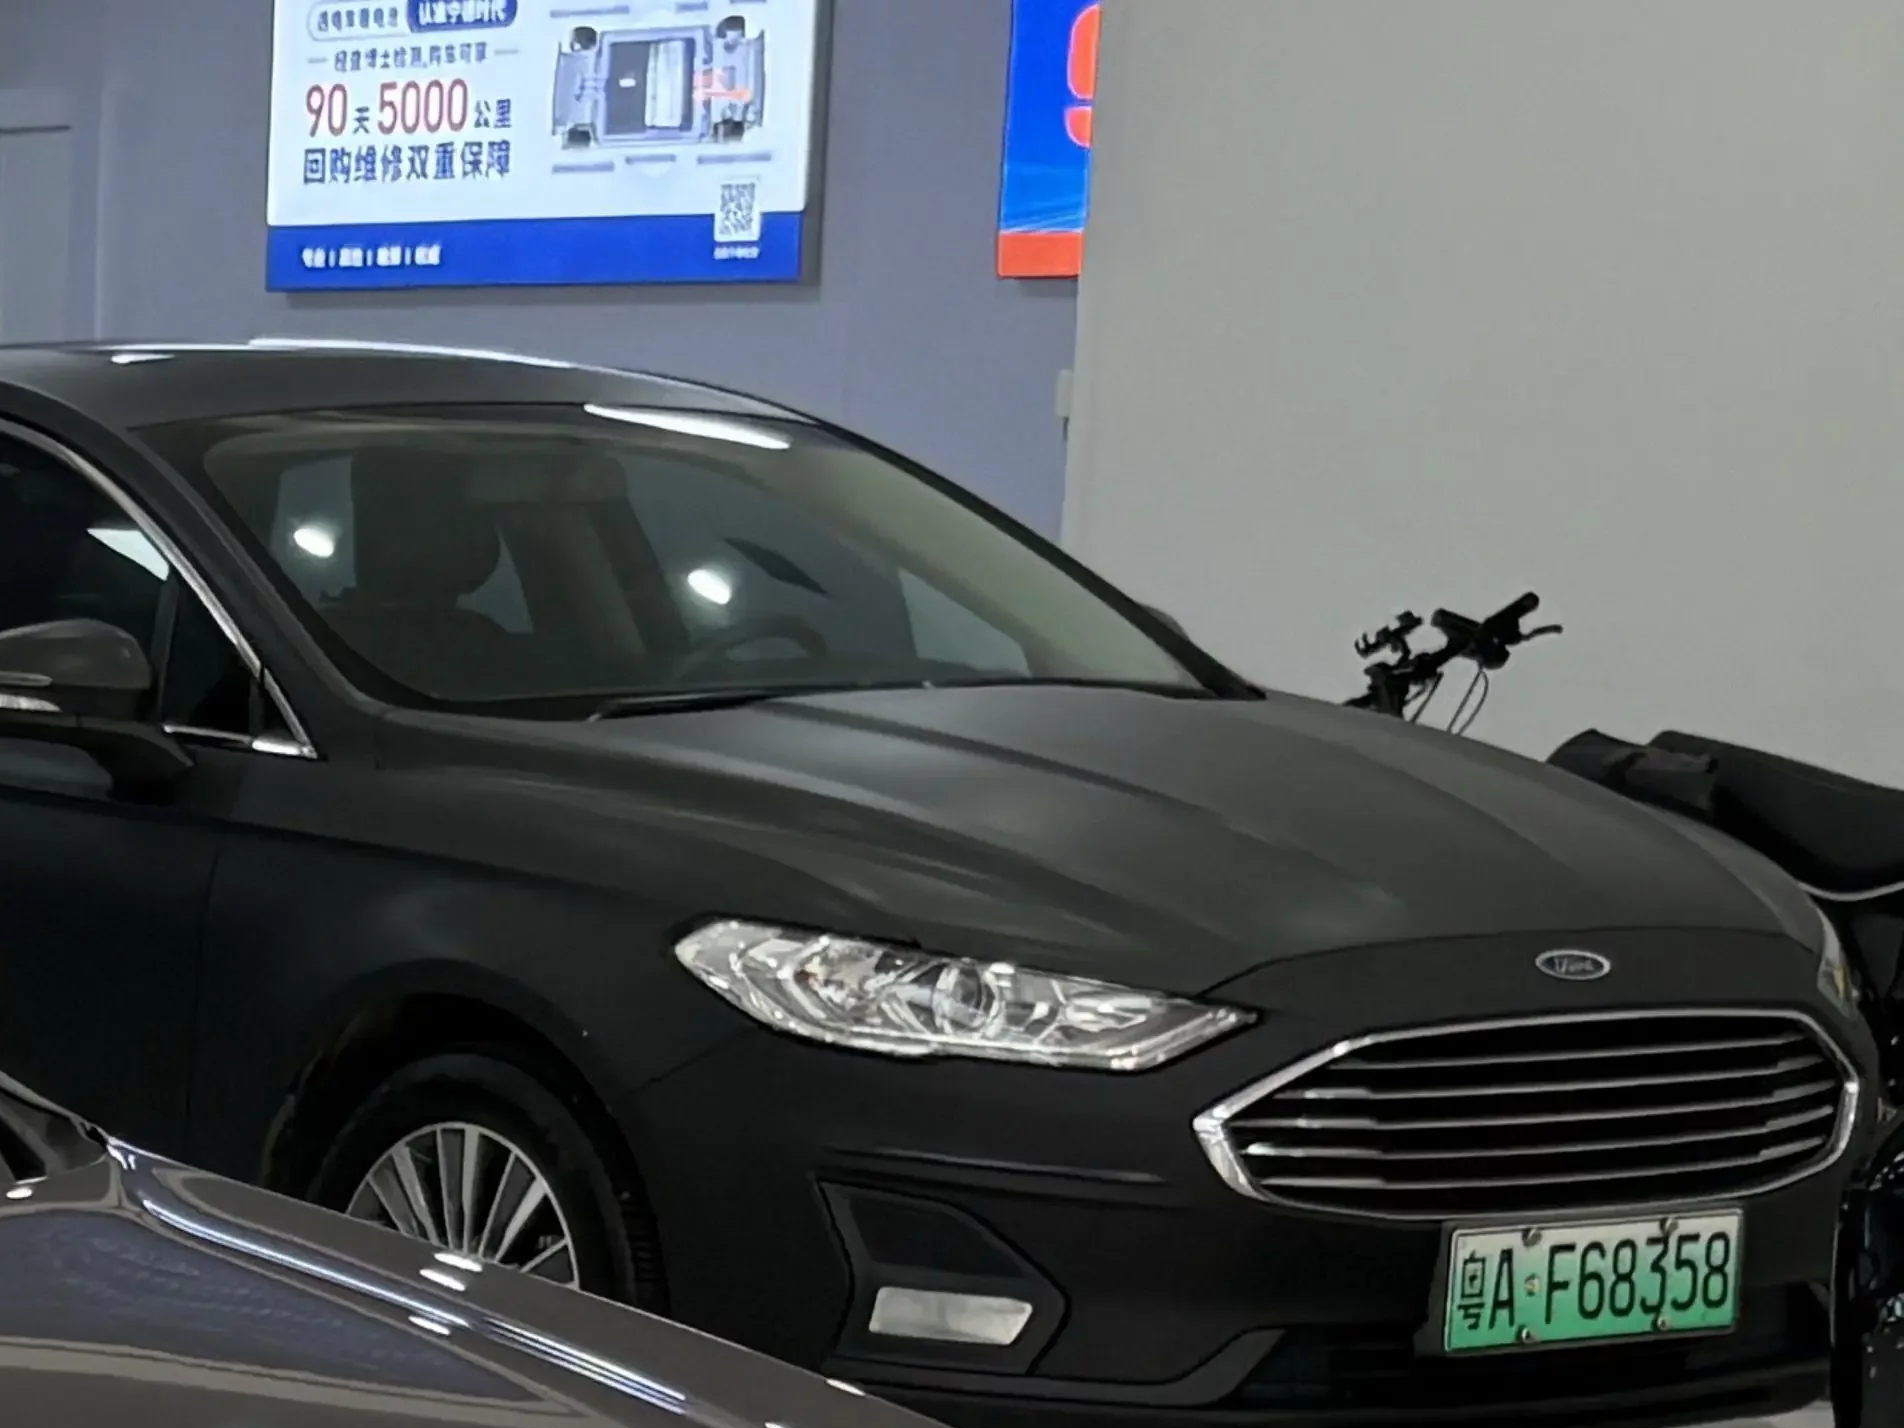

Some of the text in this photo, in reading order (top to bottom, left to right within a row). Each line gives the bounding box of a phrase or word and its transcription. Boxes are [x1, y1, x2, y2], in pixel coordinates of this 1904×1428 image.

[303, 140, 512, 185] 回购维修双重保障
